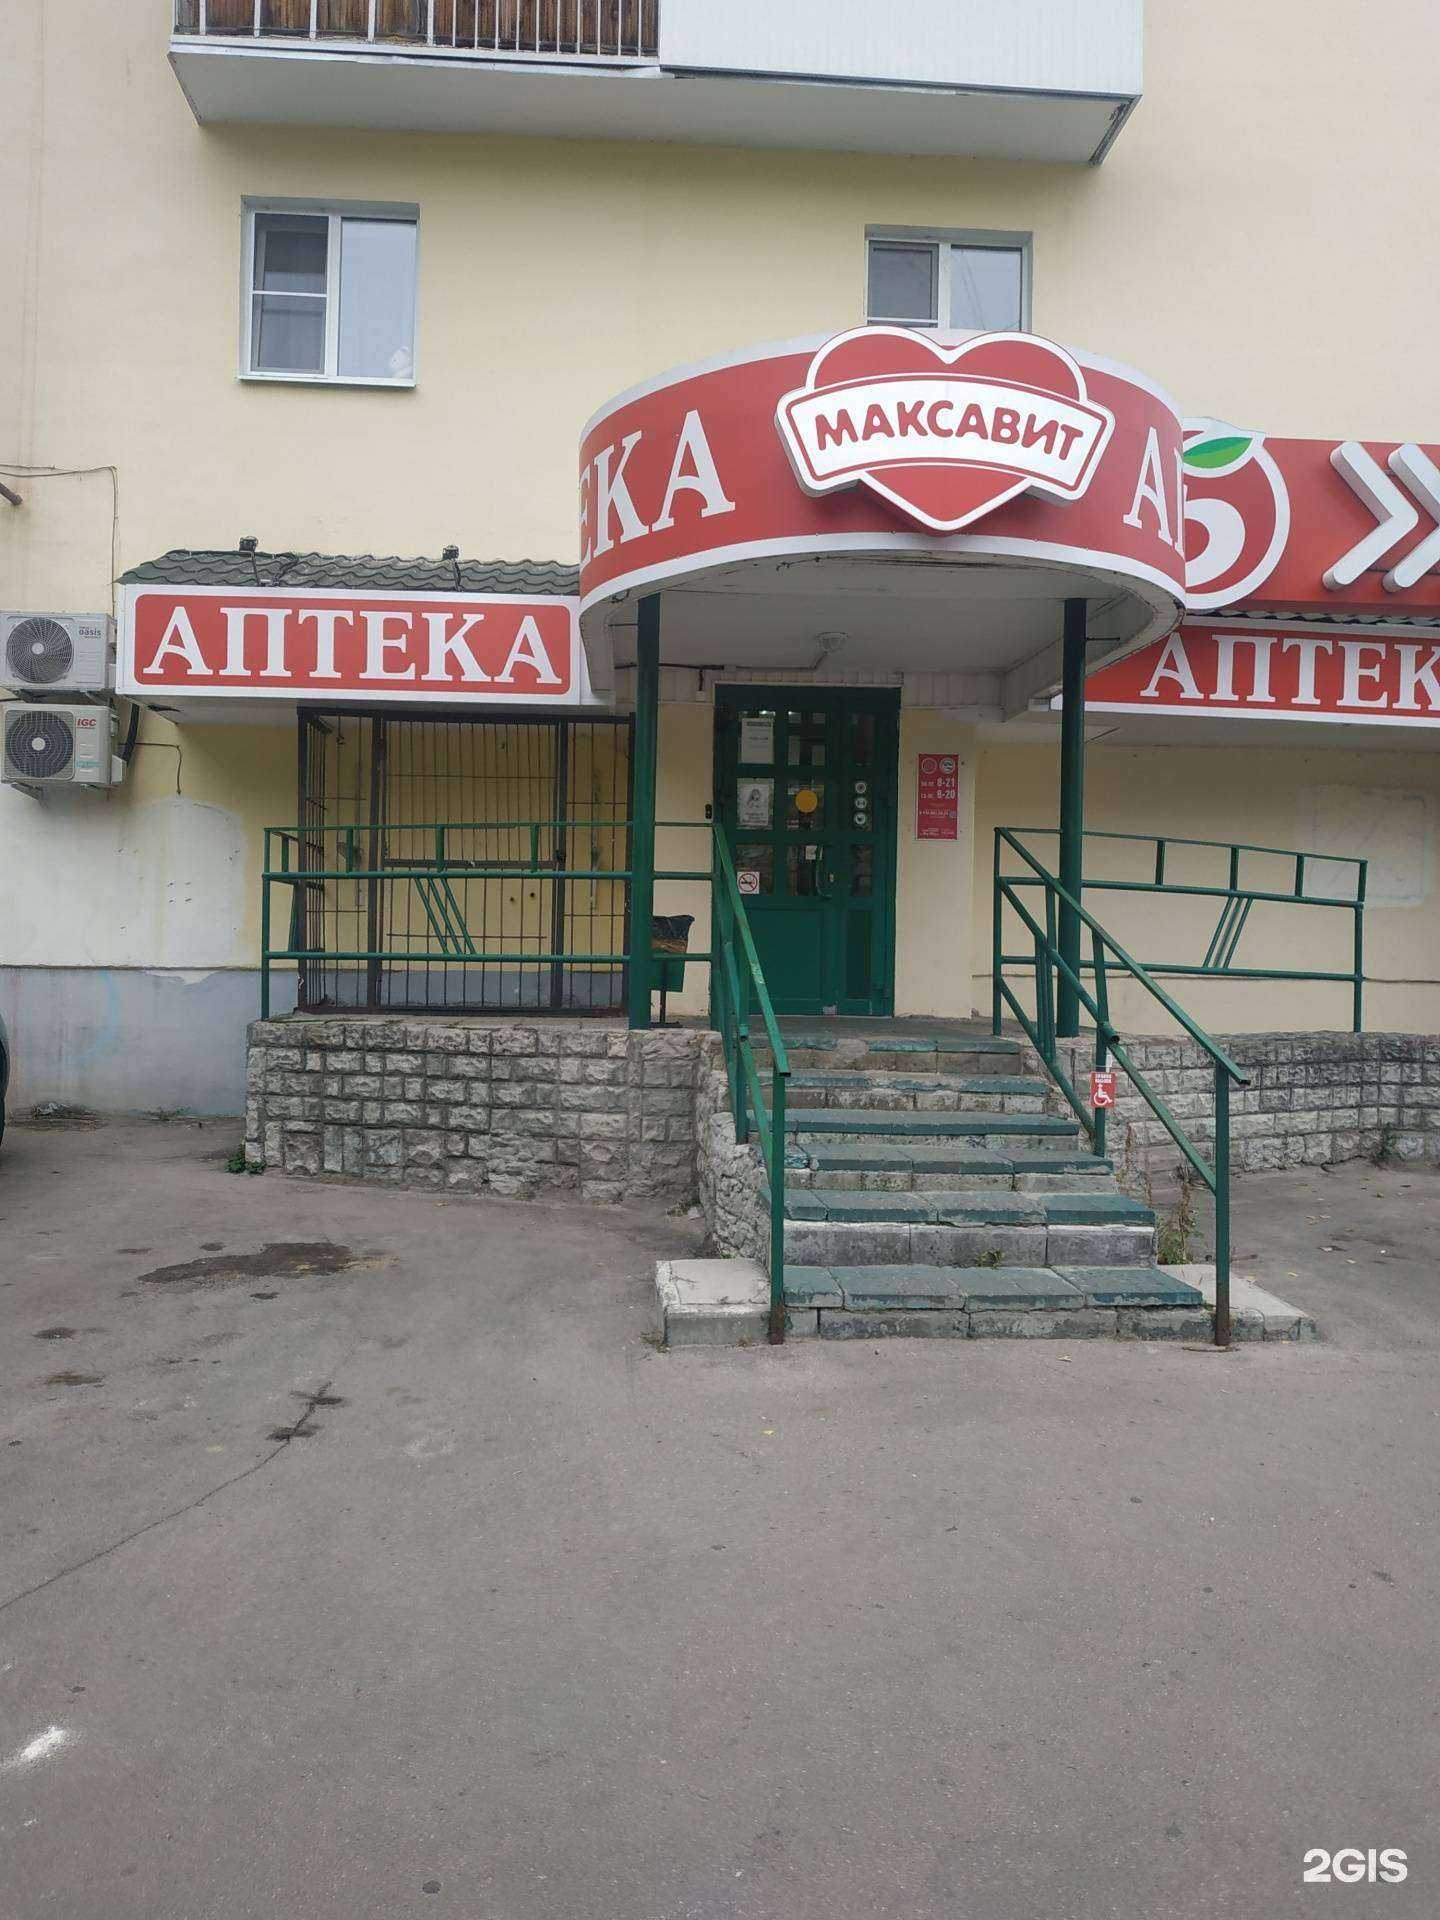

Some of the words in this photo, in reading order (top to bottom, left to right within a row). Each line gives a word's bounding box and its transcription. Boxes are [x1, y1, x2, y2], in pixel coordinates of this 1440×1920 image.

[815, 400, 1084, 461] МАКСАВИТ
[143, 606, 563, 685] АПТЕКА
[77, 718, 97, 727] IGC
